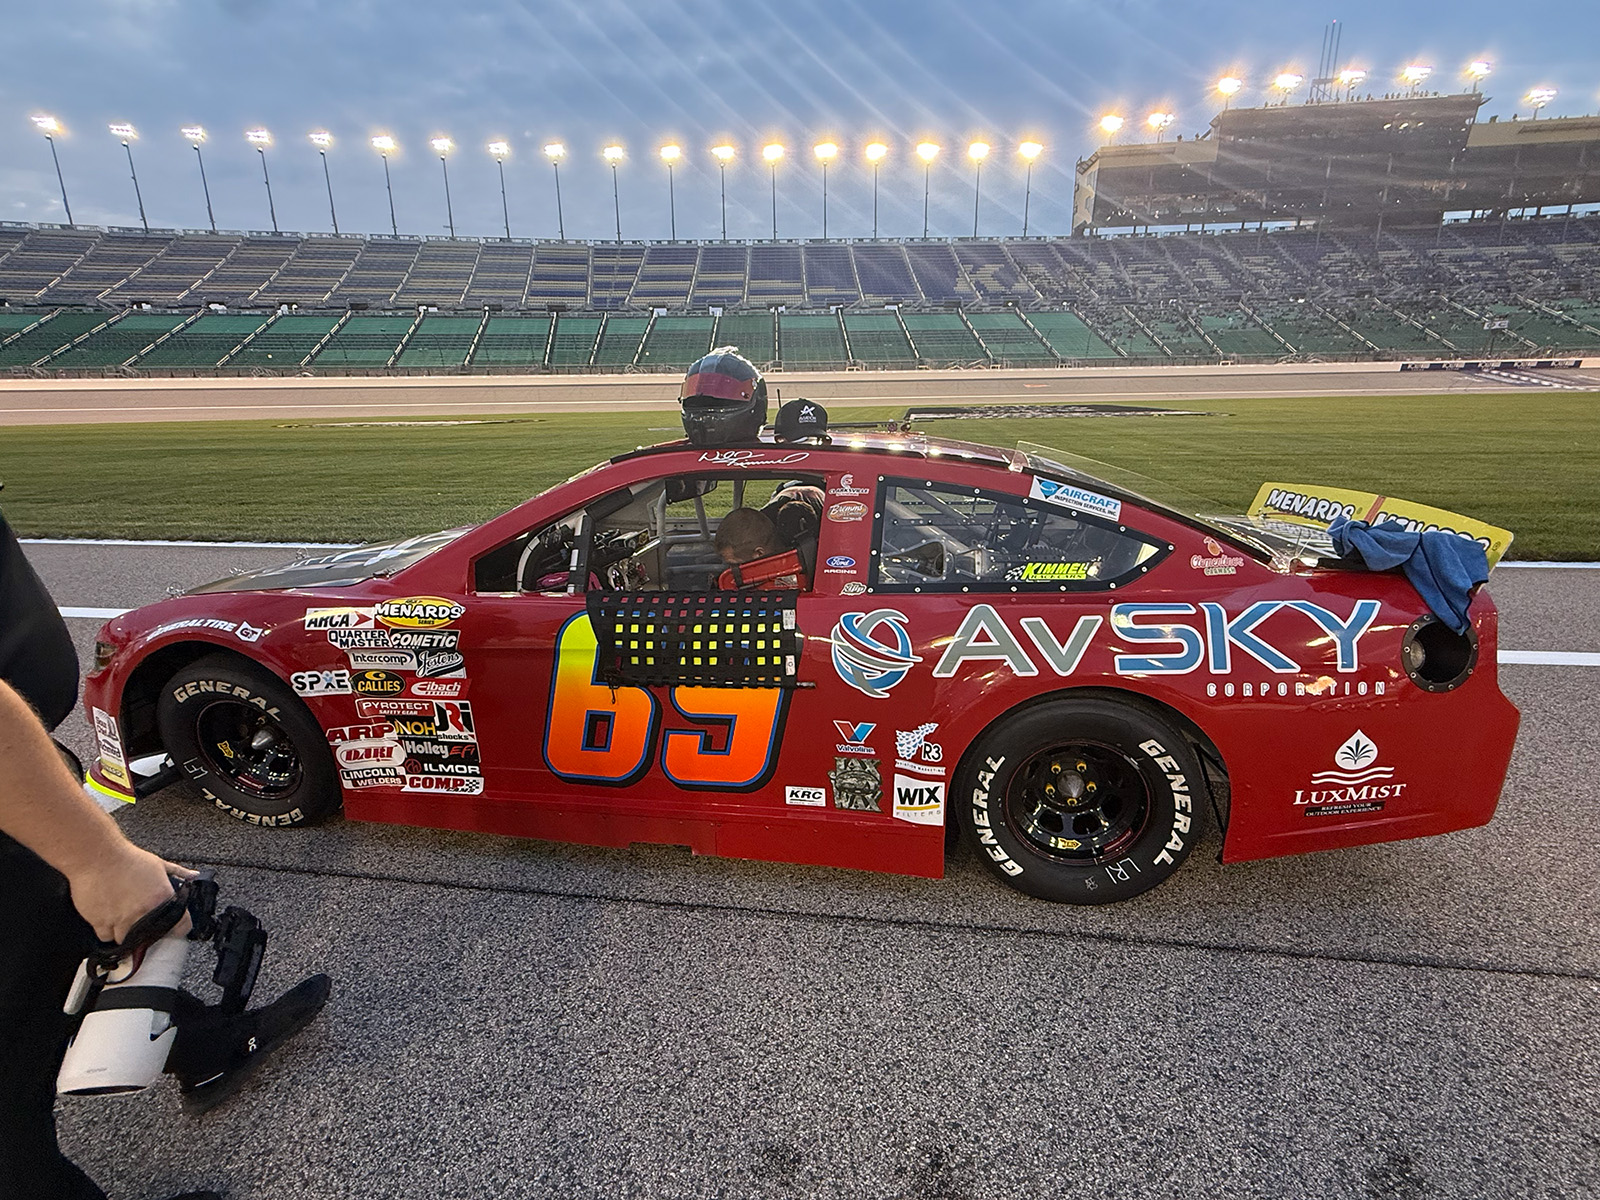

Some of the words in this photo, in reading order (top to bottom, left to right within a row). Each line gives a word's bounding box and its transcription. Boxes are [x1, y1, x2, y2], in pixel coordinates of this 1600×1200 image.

[1054, 494, 1083, 507] INSPECTION
[1060, 487, 1120, 510] AIRCRAFT
[1264, 488, 1355, 524] MENARDS
[1020, 562, 1088, 580] KIMMEL
[306, 610, 350, 628] ARCA
[375, 603, 462, 620] MENARDS
[202, 619, 238, 632] TIRE
[328, 630, 386, 643] QUARTER
[339, 638, 390, 648] MASTER
[390, 633, 457, 648] COMETIC
[353, 652, 408, 666] Intercomp
[416, 650, 464, 677] Jostens
[357, 680, 401, 692] CALLIES
[411, 681, 461, 696] Eibach
[173, 680, 281, 721] GENERAL
[362, 702, 430, 711] PYROTECT
[327, 725, 394, 742] ARP
[437, 733, 469, 741] shocks
[406, 742, 449, 759] Holley
[837, 744, 876, 754] Valvoline
[923, 743, 942, 761] R3
[343, 768, 395, 779] LINCOLN
[423, 763, 481, 775] ILMOR
[357, 777, 402, 787] WELDERS
[409, 776, 466, 789] COMP
[789, 790, 823, 800] KRC
[896, 786, 941, 805] WIX
[1139, 739, 1192, 866] GENERAL
[202, 787, 304, 827] GENERAL
[1340, 806, 1382, 814] EXPERIENCE
[972, 755, 1025, 877] GENERAL
